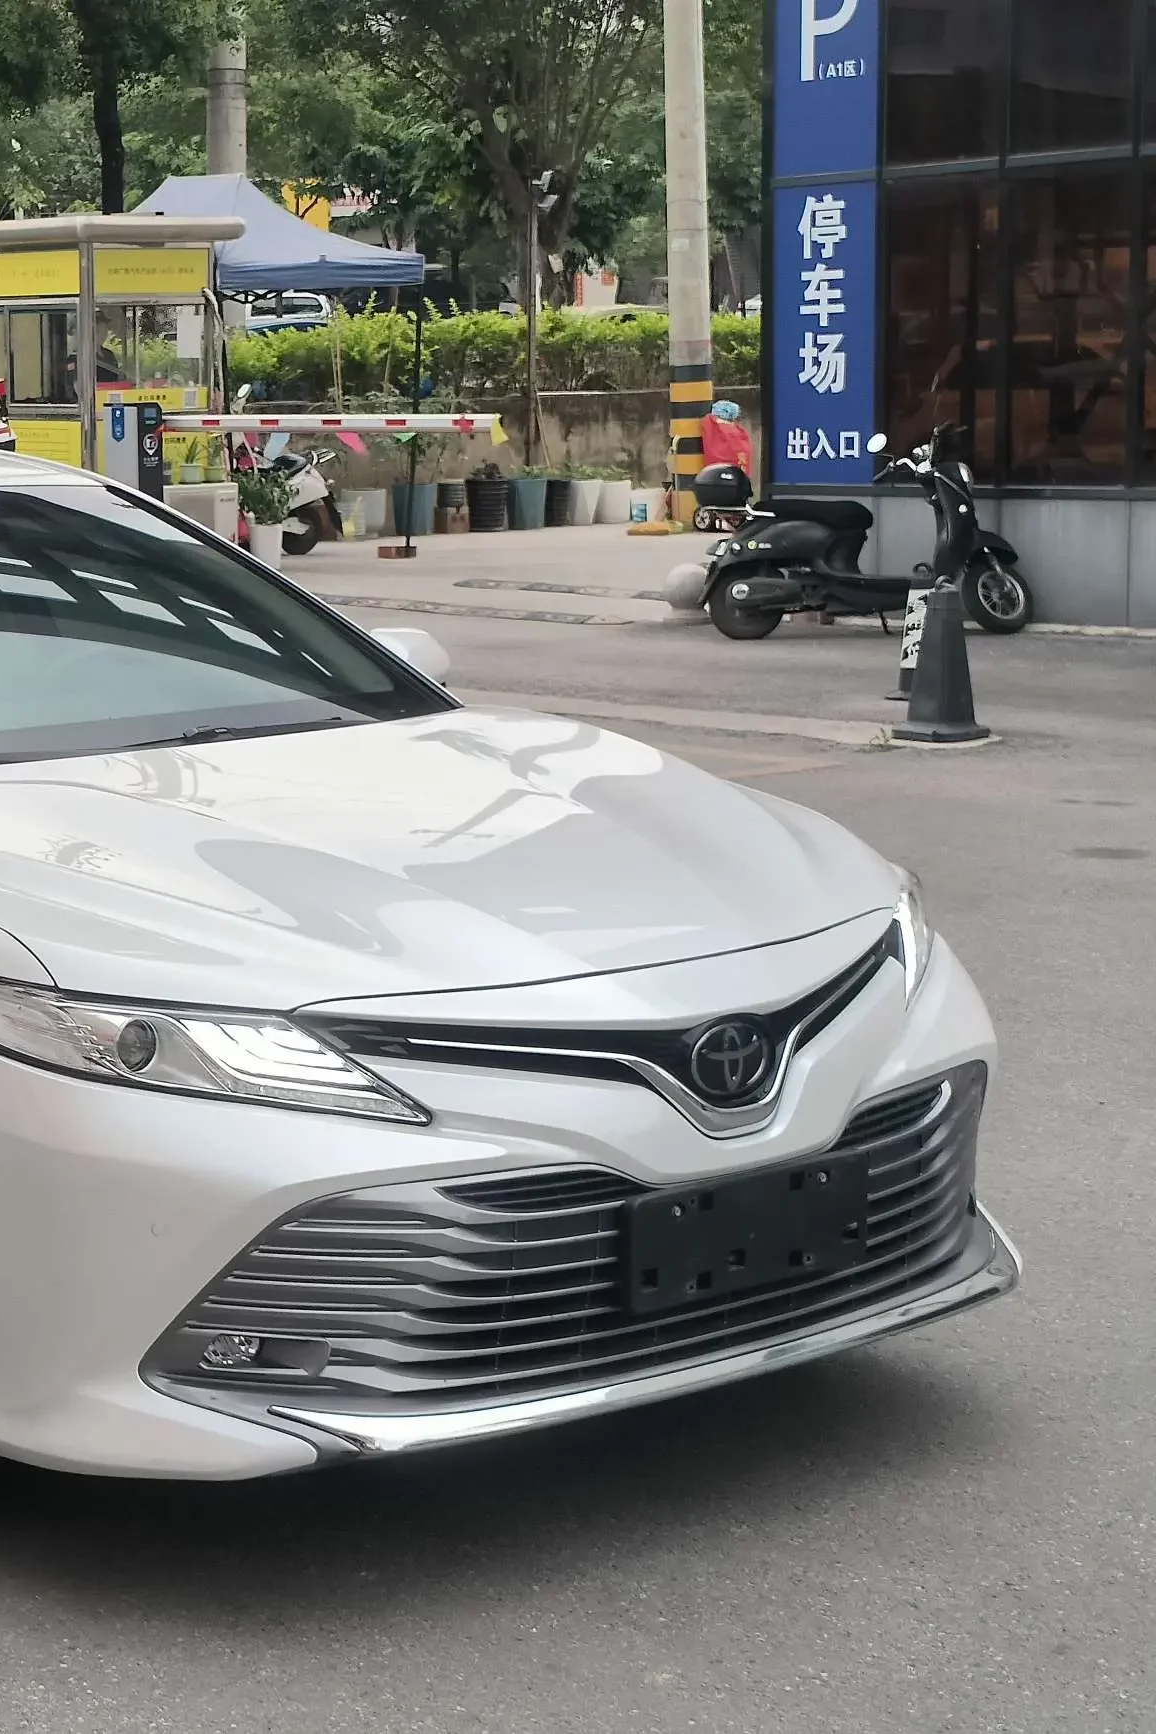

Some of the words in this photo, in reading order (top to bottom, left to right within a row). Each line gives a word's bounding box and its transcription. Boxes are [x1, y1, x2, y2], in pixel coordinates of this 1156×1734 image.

[800, 0, 860, 82] P
[797, 193, 847, 394] 停车场
[787, 427, 860, 460] 出入口
